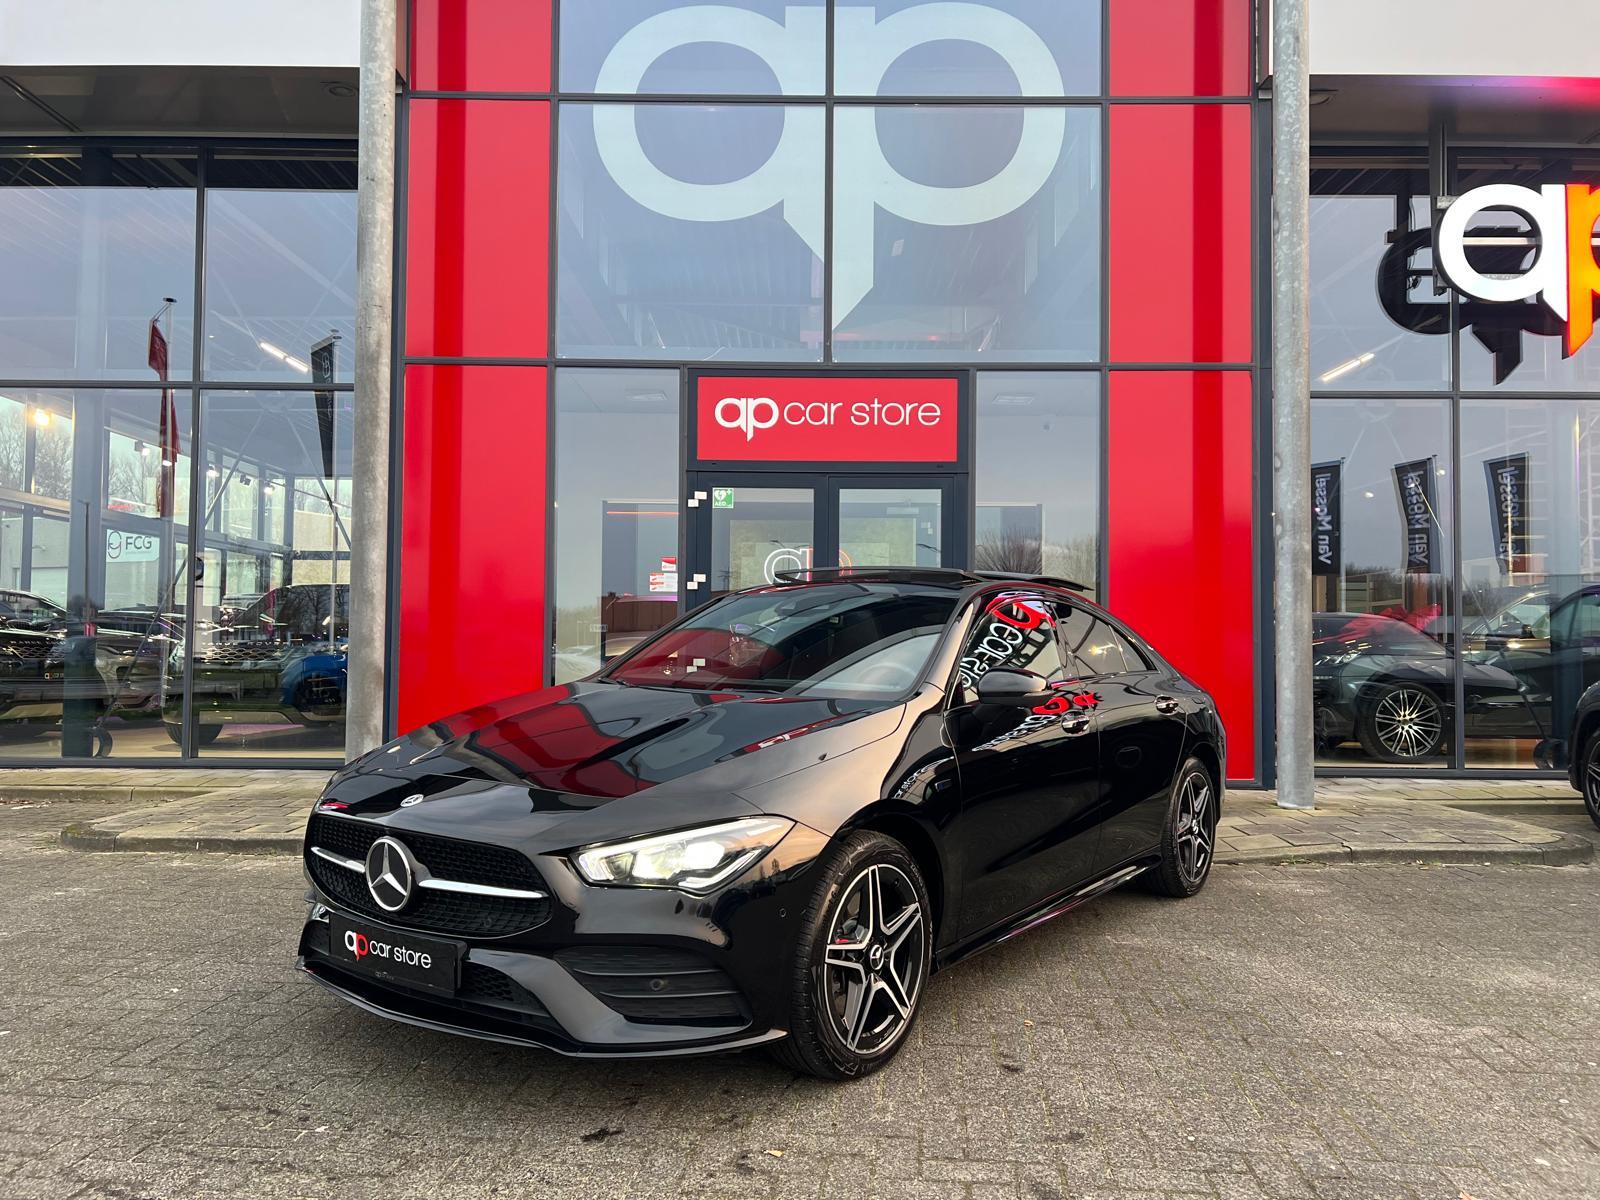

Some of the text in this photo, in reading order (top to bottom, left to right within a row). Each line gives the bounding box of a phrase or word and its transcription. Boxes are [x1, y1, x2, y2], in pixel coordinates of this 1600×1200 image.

[714, 397, 941, 442] ap car store
[125, 535, 152, 550] FCG
[344, 930, 432, 969] ap car store
